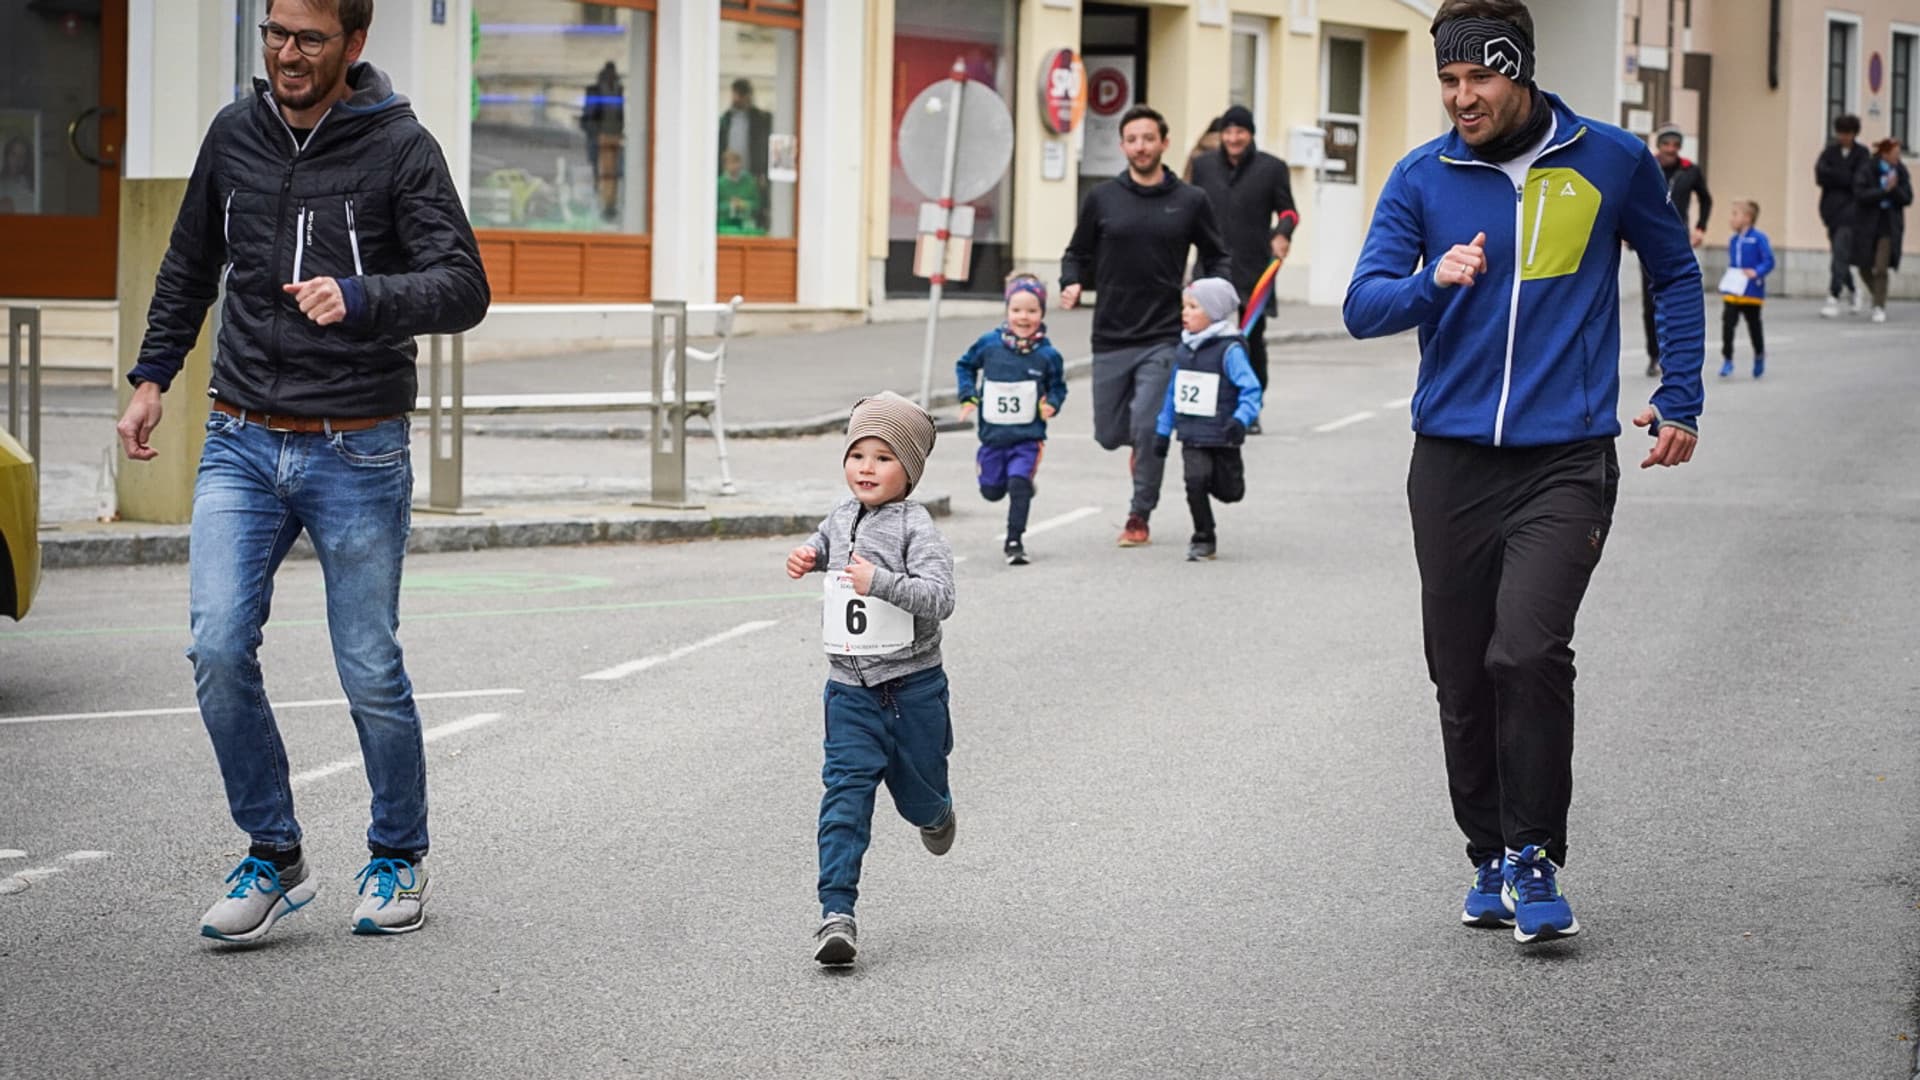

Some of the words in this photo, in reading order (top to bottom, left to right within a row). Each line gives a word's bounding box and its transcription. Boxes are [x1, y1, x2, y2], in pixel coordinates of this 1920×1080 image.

[1180, 385, 1200, 403] 52
[997, 396, 1021, 414] 53
[846, 600, 867, 635] 6
